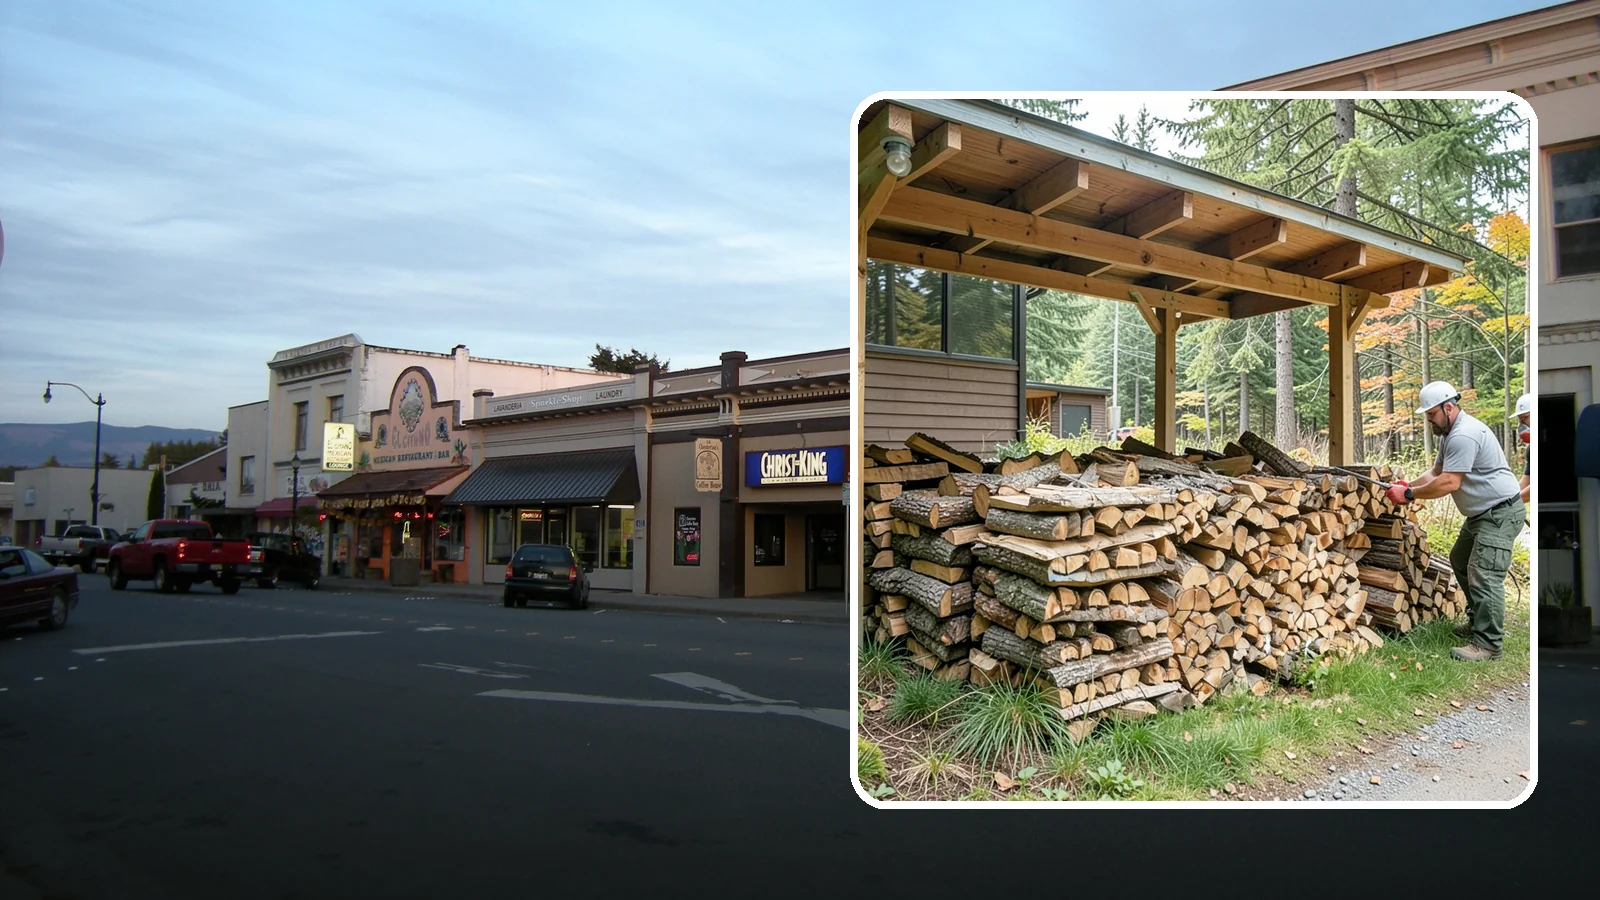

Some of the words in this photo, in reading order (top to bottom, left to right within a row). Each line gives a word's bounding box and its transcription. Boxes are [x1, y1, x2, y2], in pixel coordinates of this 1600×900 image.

[562, 395, 582, 405] Shop
[595, 389, 624, 400] LAUNDRY
[493, 402, 523, 413] LAVANDERIA
[373, 455, 396, 464] MEXICAN
[397, 451, 433, 462] RESTAURANT
[438, 450, 450, 458] BAR
[761, 452, 797, 477] CHRIST
[799, 450, 827, 476] KING
